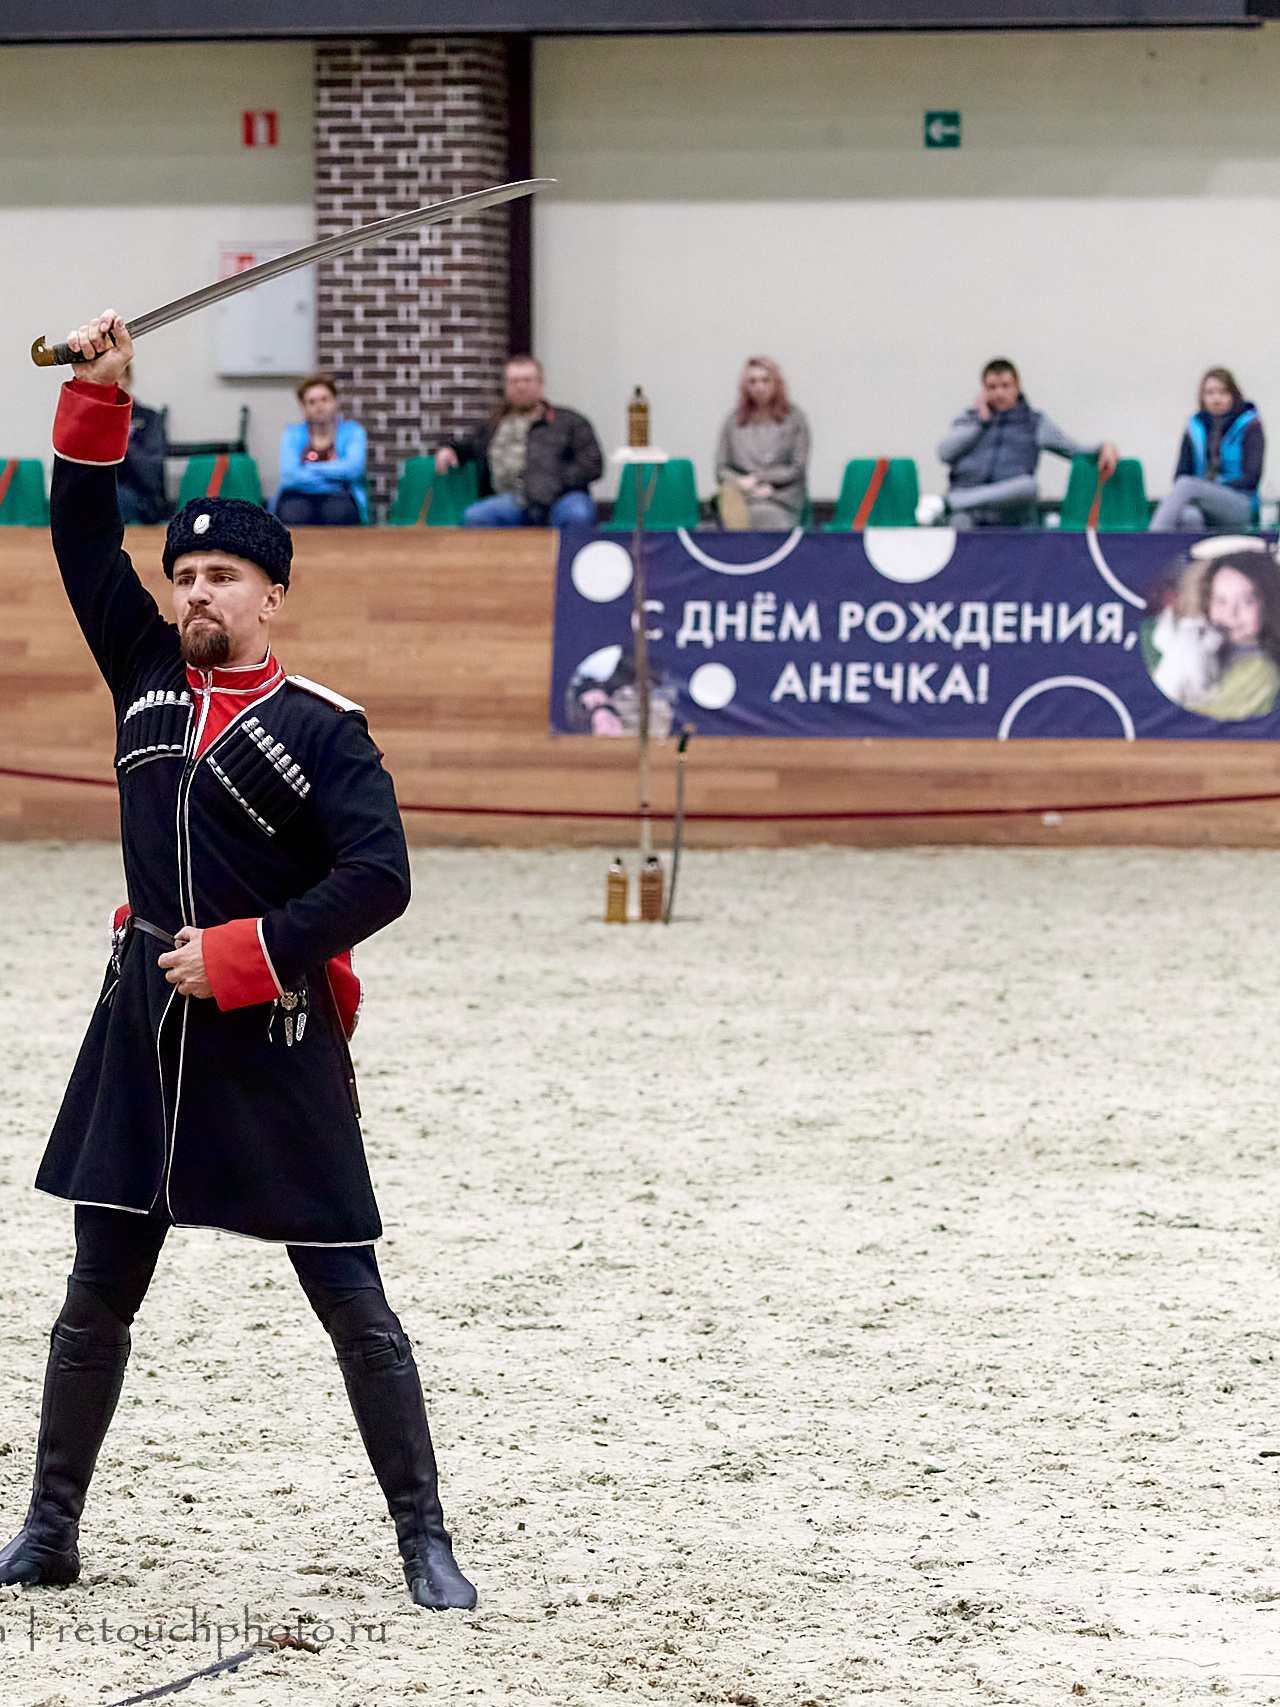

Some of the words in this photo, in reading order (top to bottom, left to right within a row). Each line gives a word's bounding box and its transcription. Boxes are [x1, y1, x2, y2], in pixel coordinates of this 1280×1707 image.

[631, 600, 665, 640] С
[675, 591, 822, 649] ДНЁМ
[838, 600, 1138, 651] РОЖДЕНИЯ,
[770, 661, 990, 704] АНЕЧКА!
